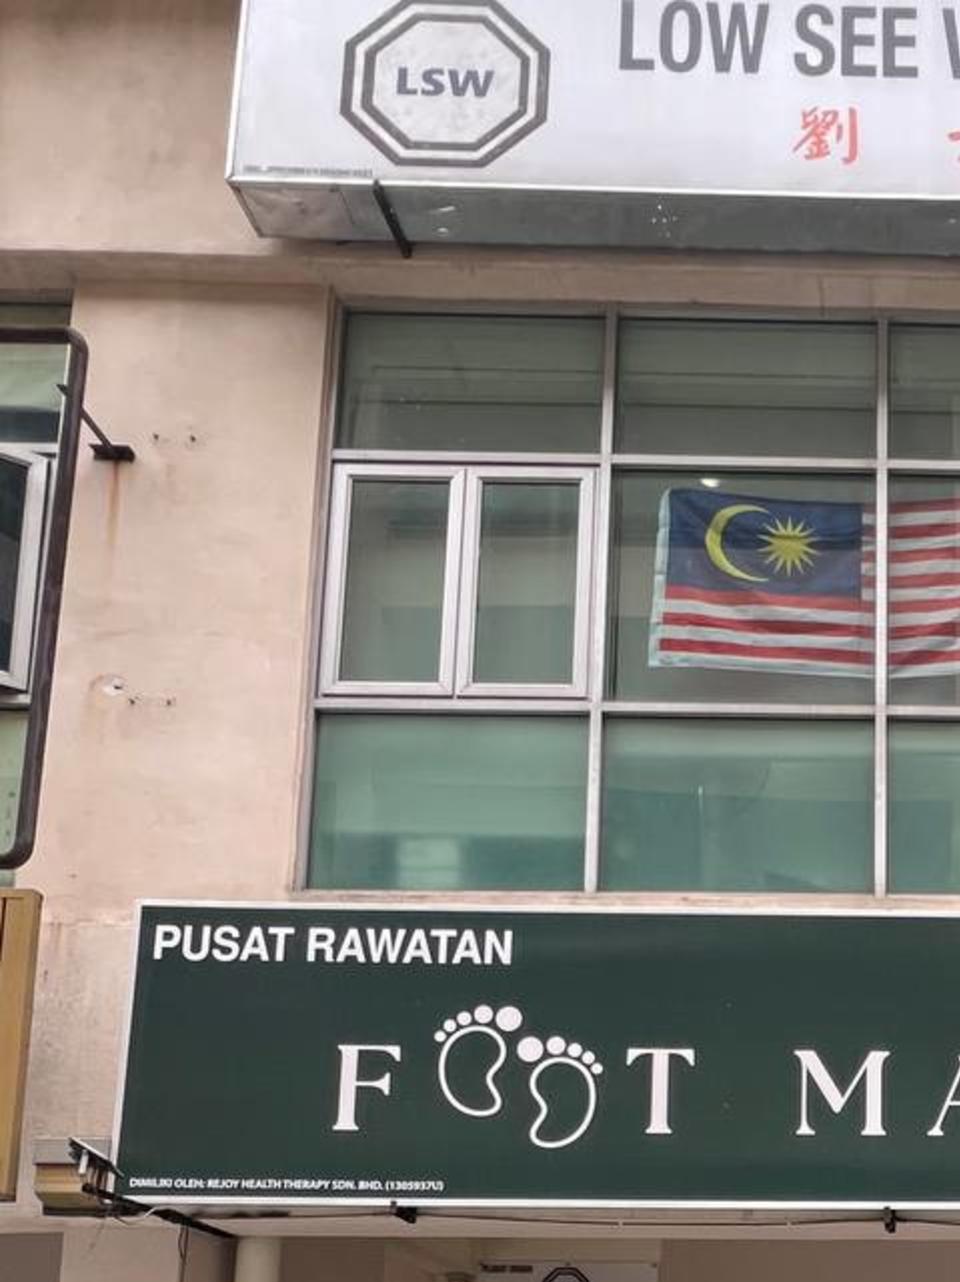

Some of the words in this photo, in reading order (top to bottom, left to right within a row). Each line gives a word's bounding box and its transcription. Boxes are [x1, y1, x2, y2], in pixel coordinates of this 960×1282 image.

[619, 0, 765, 73] LOW
[794, 5, 919, 79] SEE
[396, 65, 495, 98] LSW
[152, 925, 294, 961] PUSAT
[306, 927, 513, 965] RAWATAN
[207, 1179, 240, 1189] REJOY
[241, 1179, 281, 1190] HEALTH
[282, 1179, 331, 1190] THERAPY
[332, 1180, 356, 1190] SDN.
[358, 1181, 383, 1190] BHD.
